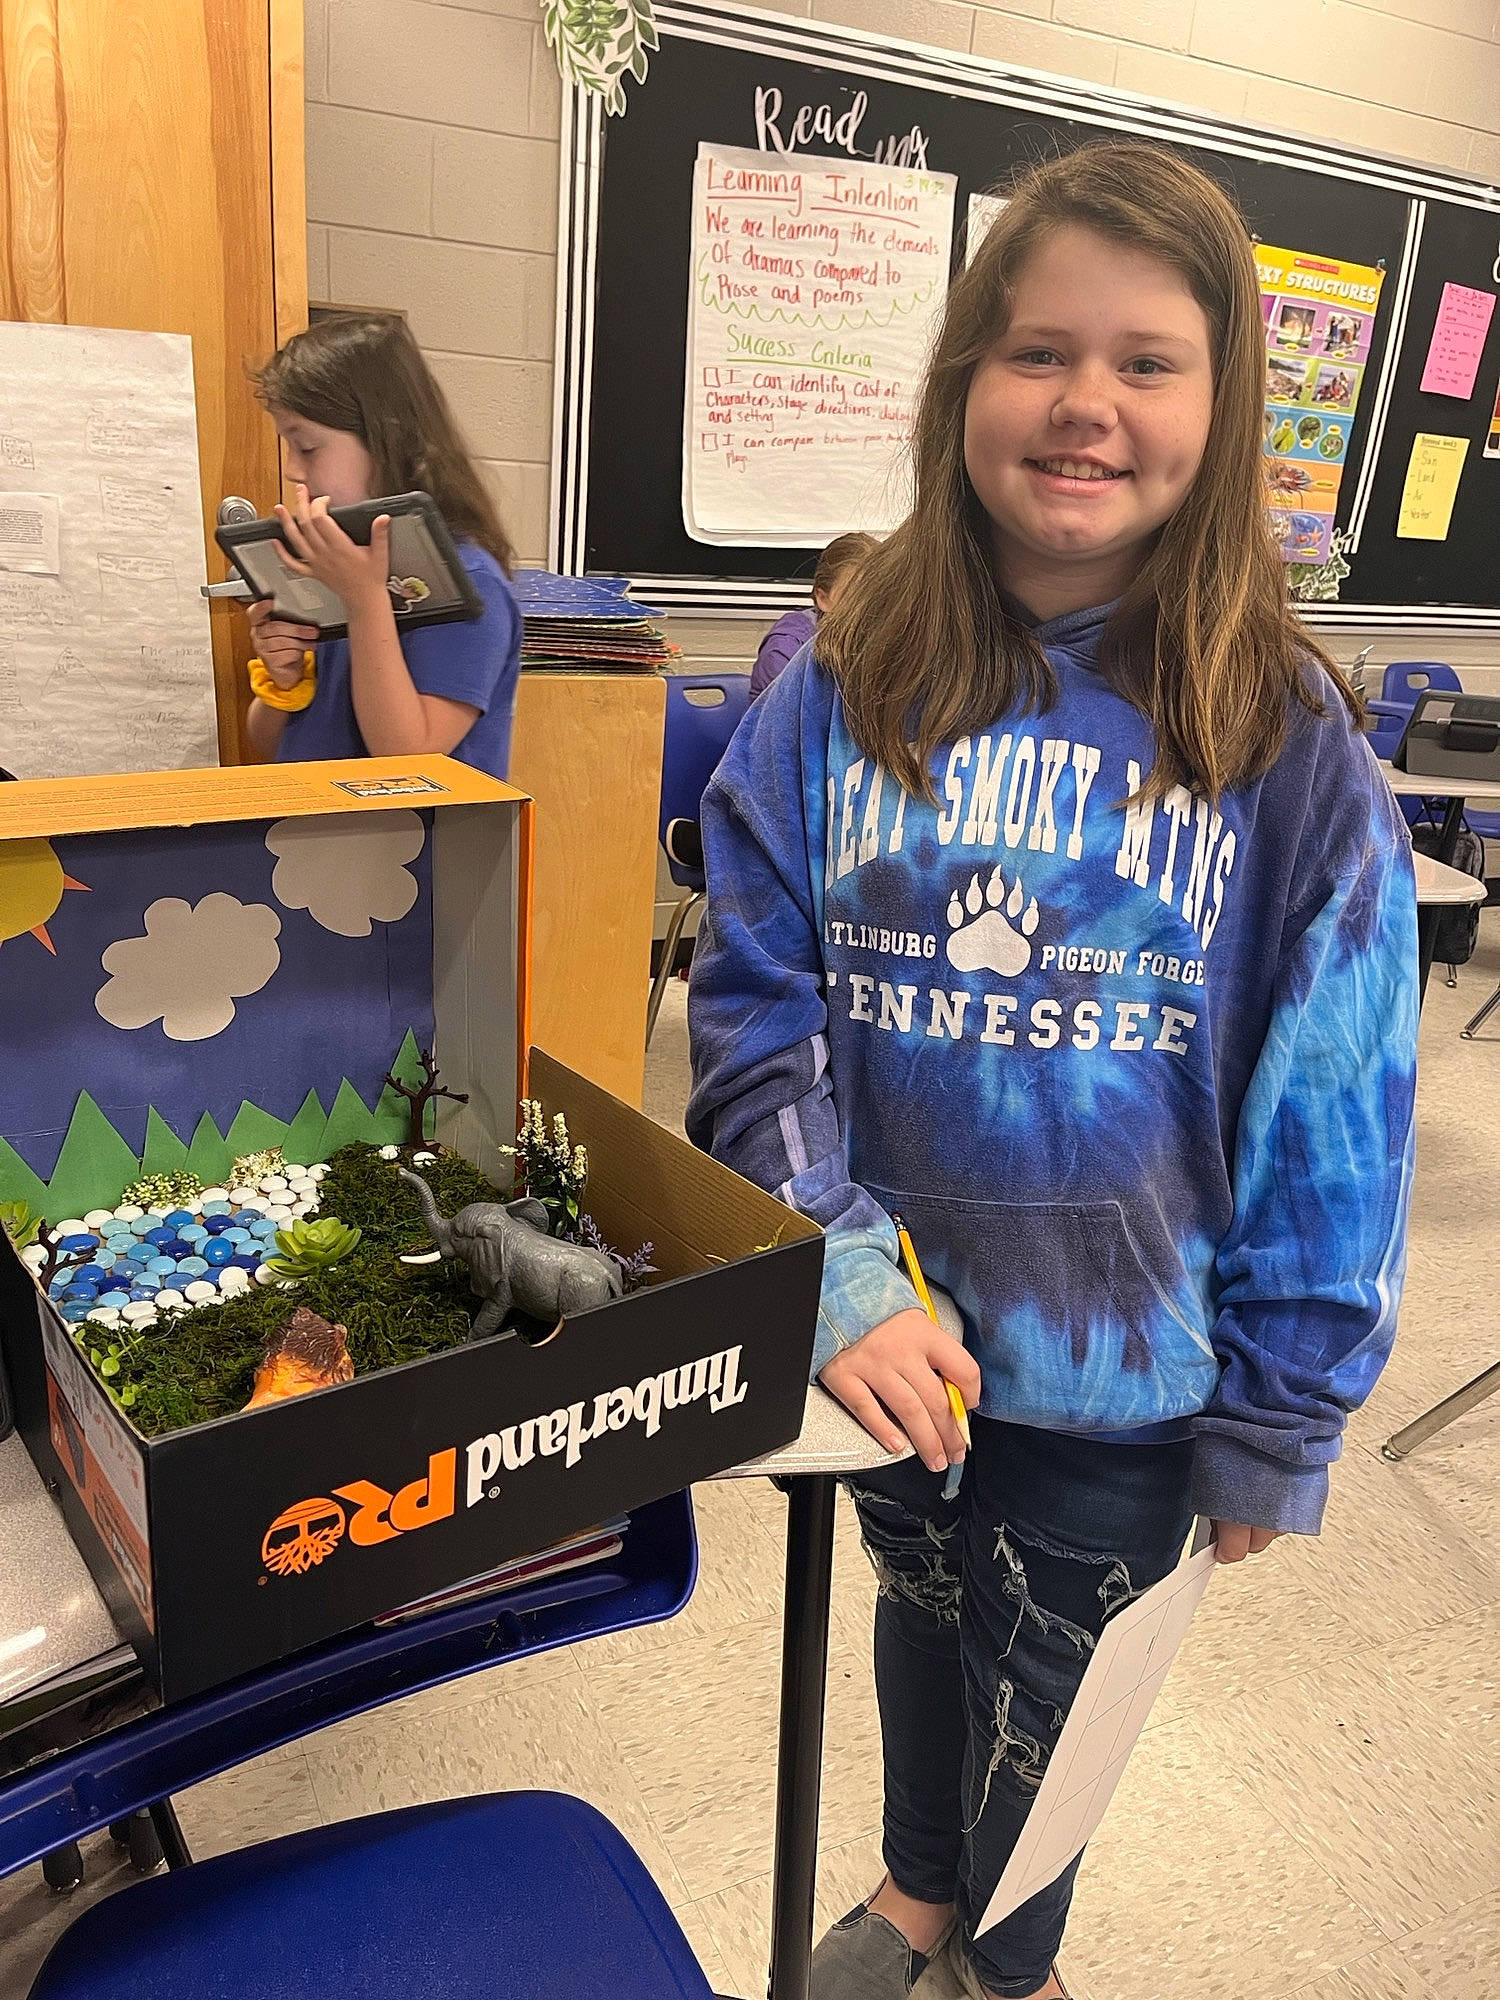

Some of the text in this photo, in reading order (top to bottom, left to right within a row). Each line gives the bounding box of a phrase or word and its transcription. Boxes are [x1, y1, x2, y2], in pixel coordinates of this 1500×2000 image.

[707, 157, 802, 217] Learning
[822, 174, 919, 212] Intention
[705, 205, 940, 257] We are learning the elements
[742, 245, 805, 279] dramas
[886, 259, 902, 285] to
[718, 273, 864, 309] Prose and poems
[1287, 271, 1377, 305] STRUCTURES
[727, 323, 873, 369] Success Criteria
[726, 368, 742, 385] I
[753, 372, 783, 390] can
[790, 374, 846, 405] identify
[708, 409, 732, 424] and
[743, 437, 765, 449] can
[937, 733, 1101, 861] SMOKY
[1115, 759, 1238, 952] MTNS
[1040, 945, 1206, 986] PIGEON FORGE
[466, 1344, 749, 1508] Timberland
